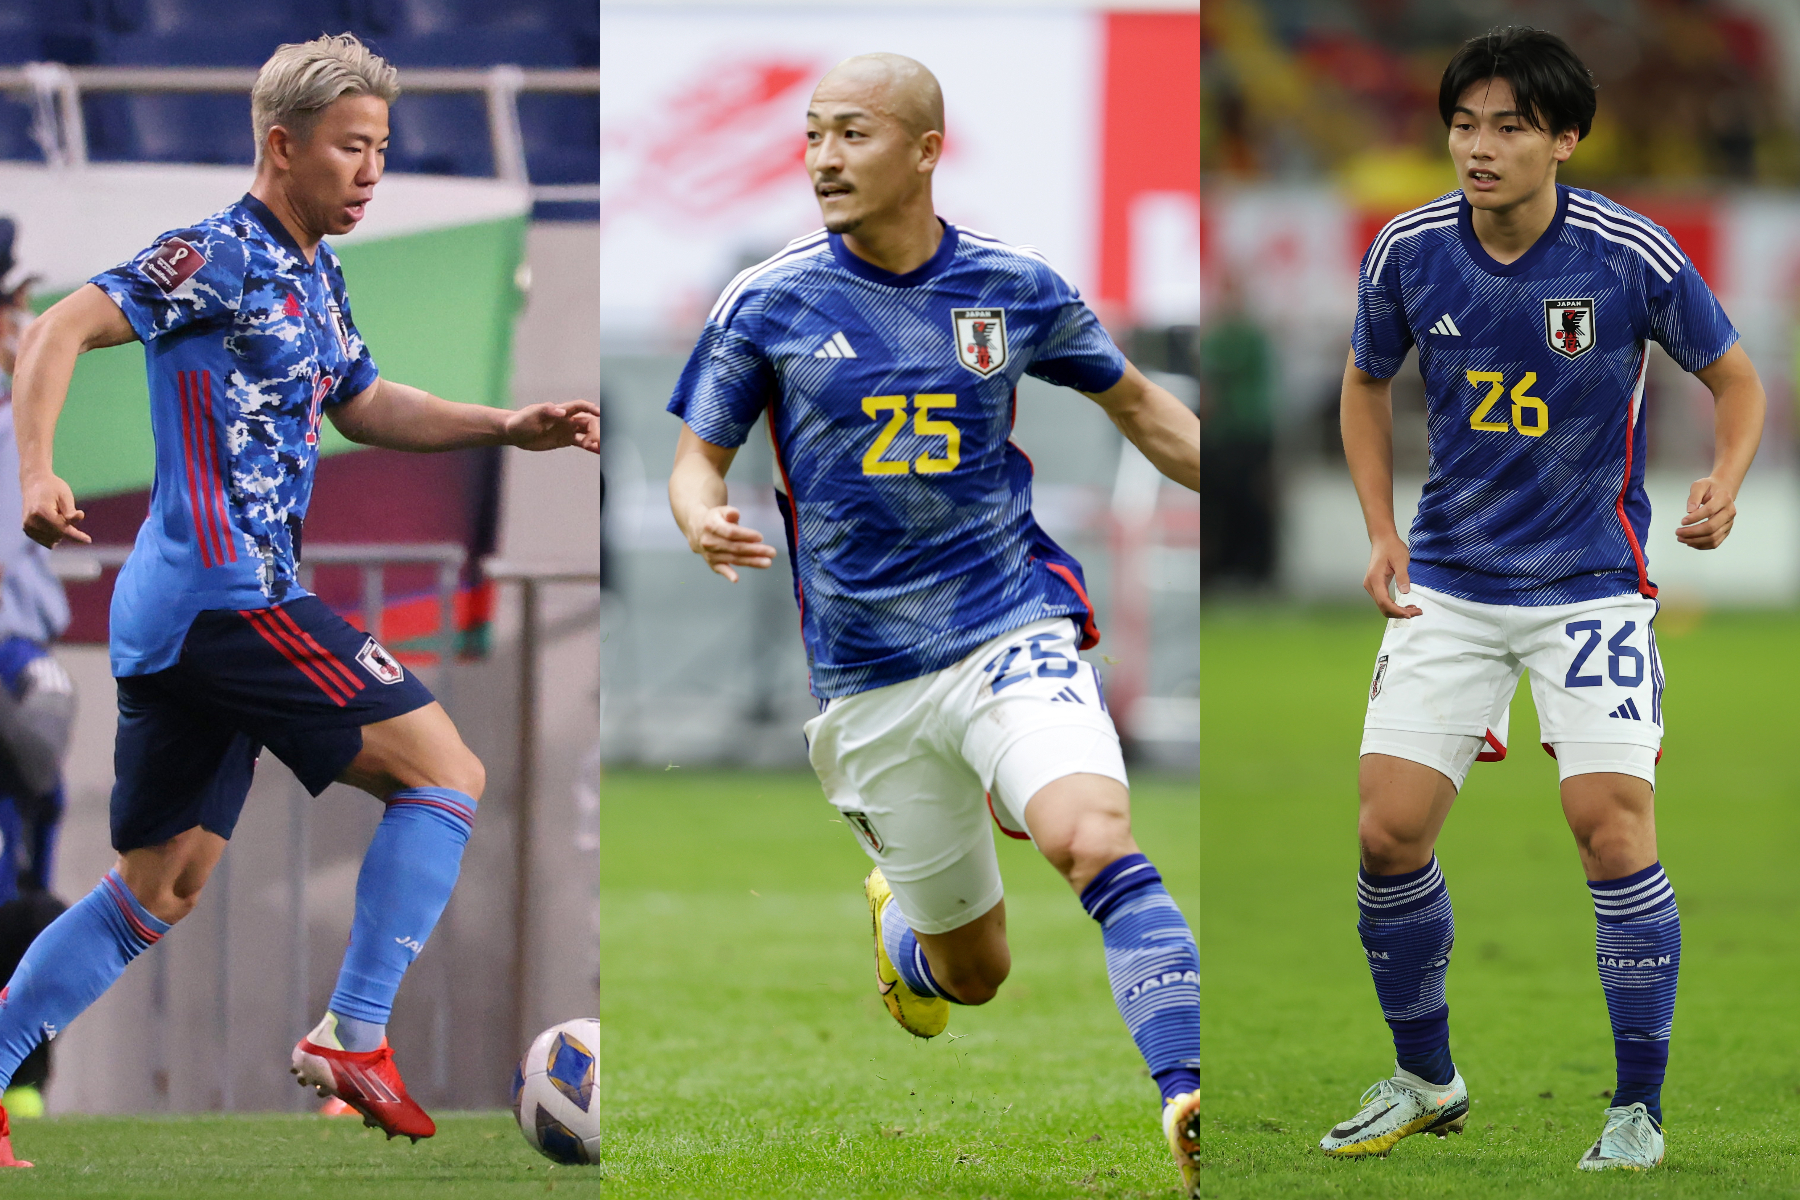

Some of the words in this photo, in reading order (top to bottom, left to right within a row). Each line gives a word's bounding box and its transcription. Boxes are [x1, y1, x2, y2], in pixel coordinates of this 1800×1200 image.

[973, 353, 995, 365] JFA
[1560, 339, 1582, 349] JFA
[1466, 369, 1549, 438] 26
[861, 393, 961, 476] 25
[983, 633, 1078, 696] 25
[1564, 619, 1645, 688] 26
[1598, 954, 1671, 968] JAPAN
[1128, 970, 1200, 1002] JAPA
